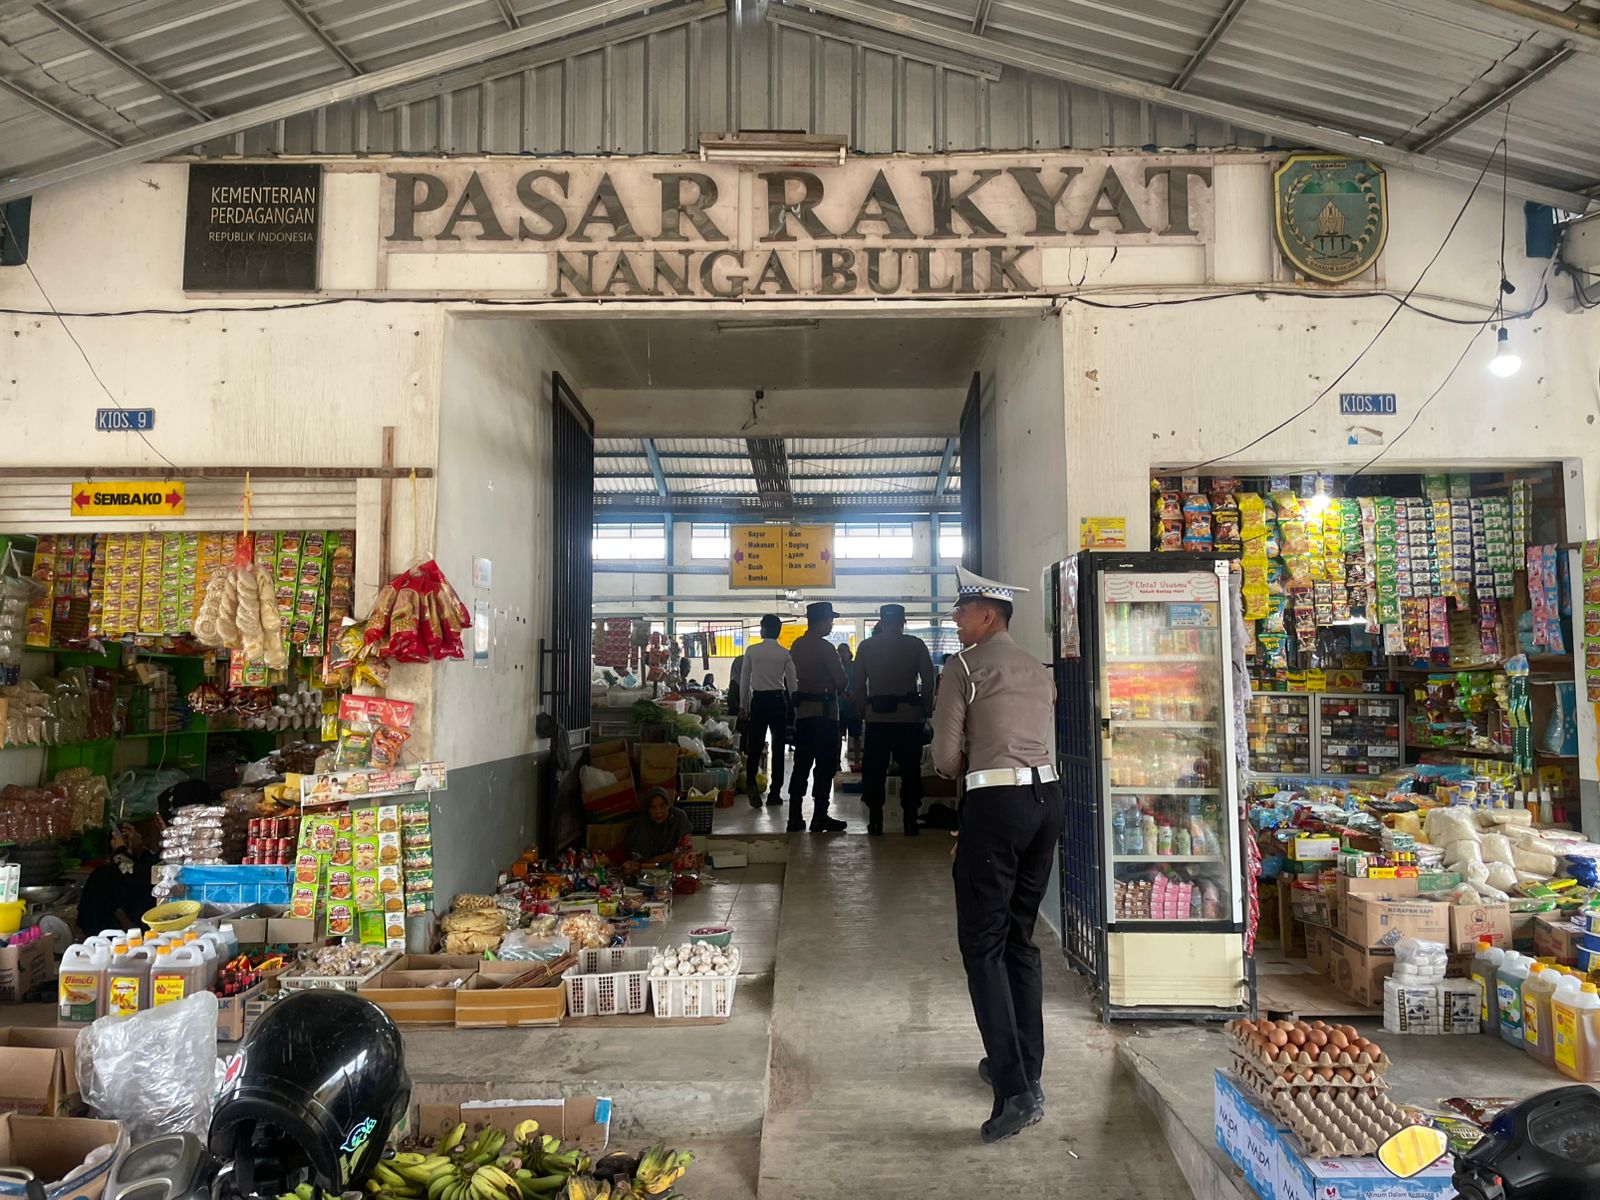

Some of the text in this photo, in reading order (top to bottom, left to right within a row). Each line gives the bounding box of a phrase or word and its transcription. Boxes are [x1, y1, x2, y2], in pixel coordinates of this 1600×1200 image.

[211, 186, 315, 204] KEMENTERIAN
[385, 164, 1213, 243] PASAR RAKYAT
[210, 207, 314, 224] PERDAGANGAN
[208, 231, 314, 242] REPUBLIK INDONESIA
[551, 245, 1040, 298] NANGA BULIK
[99, 411, 147, 429] KIOS. 9
[93, 492, 162, 506] SEMBAKO
[65, 976, 94, 985] Bimoli
